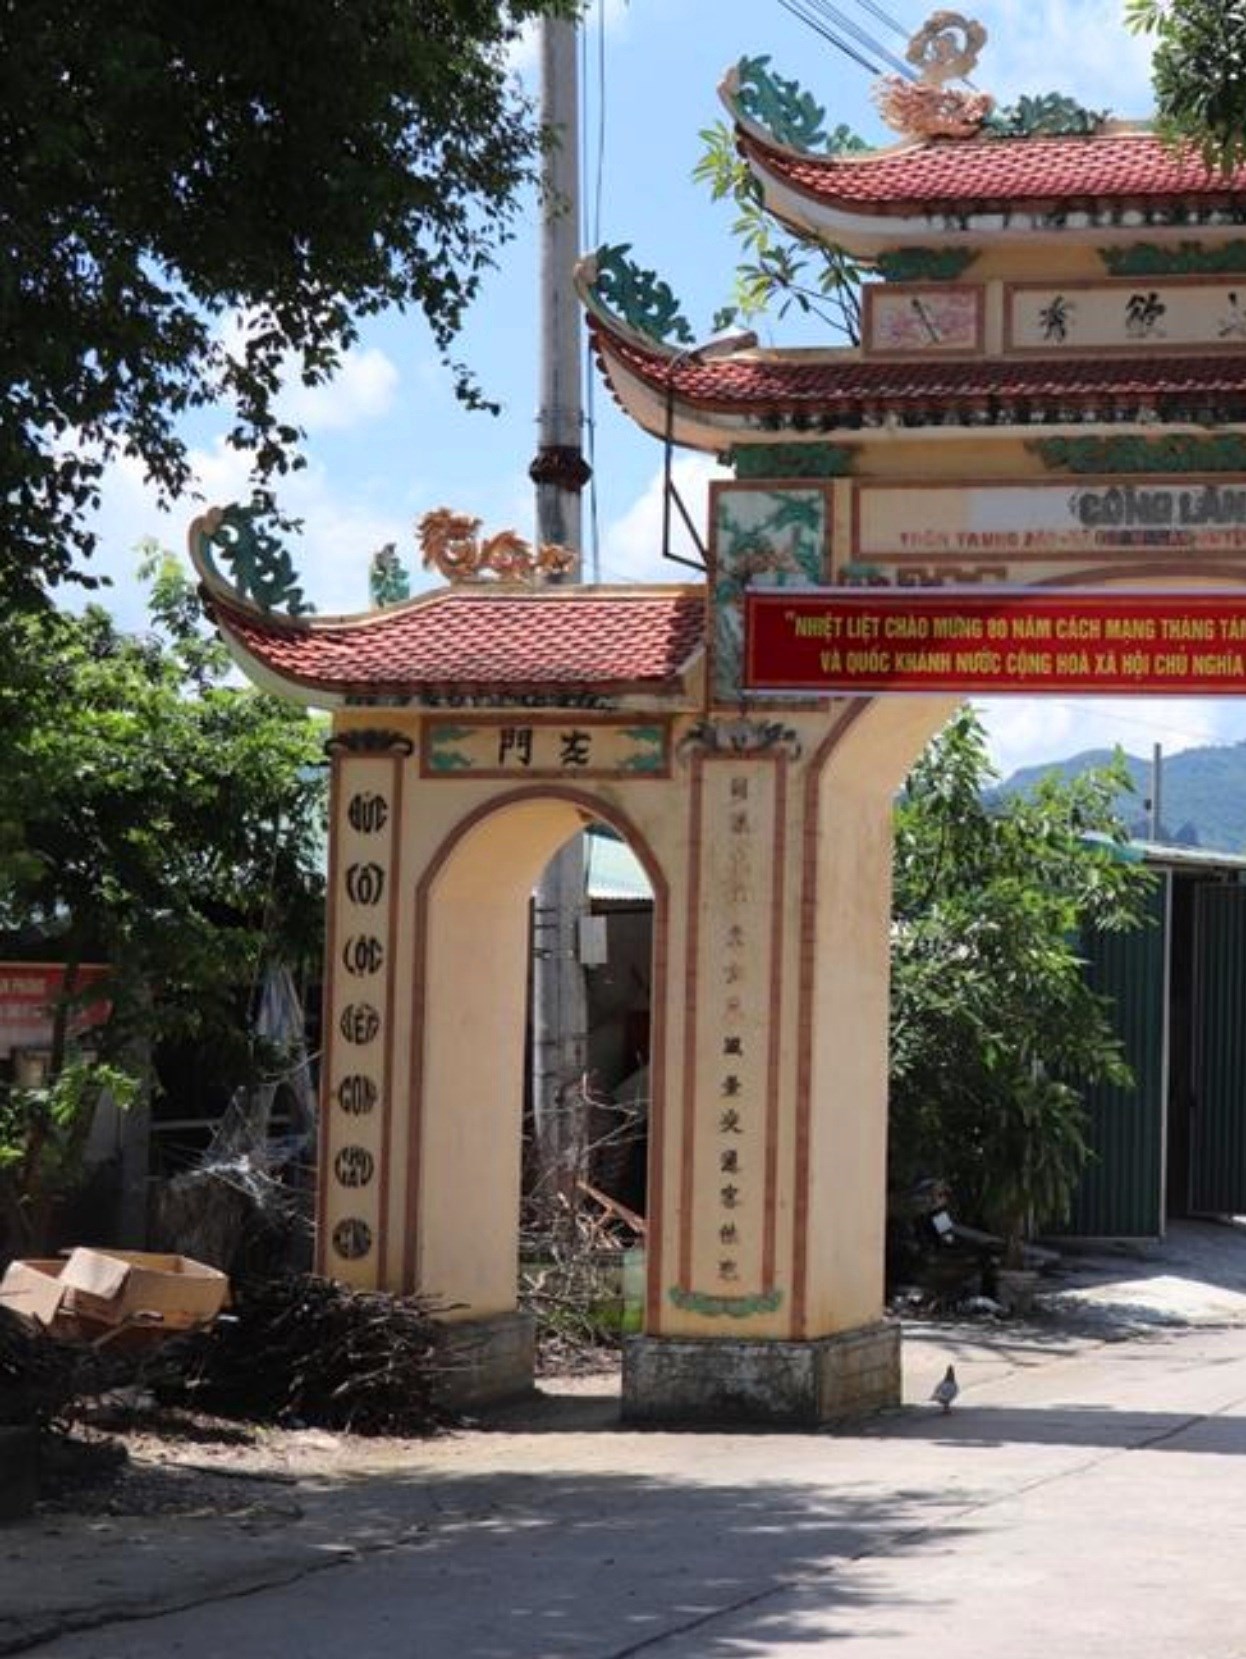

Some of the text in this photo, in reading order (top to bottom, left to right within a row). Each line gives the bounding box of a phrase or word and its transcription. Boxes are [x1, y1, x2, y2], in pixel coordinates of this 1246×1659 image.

[1055, 614, 1101, 640] CÁCH
[1160, 614, 1214, 641] THÁNG
[819, 648, 842, 673] VÀ
[845, 646, 891, 675] QUỐC
[894, 648, 952, 674] KHÁNH
[1005, 647, 1052, 679] CỘNG
[1121, 648, 1150, 680] HỘI
[1153, 645, 1188, 676] CHỦ
